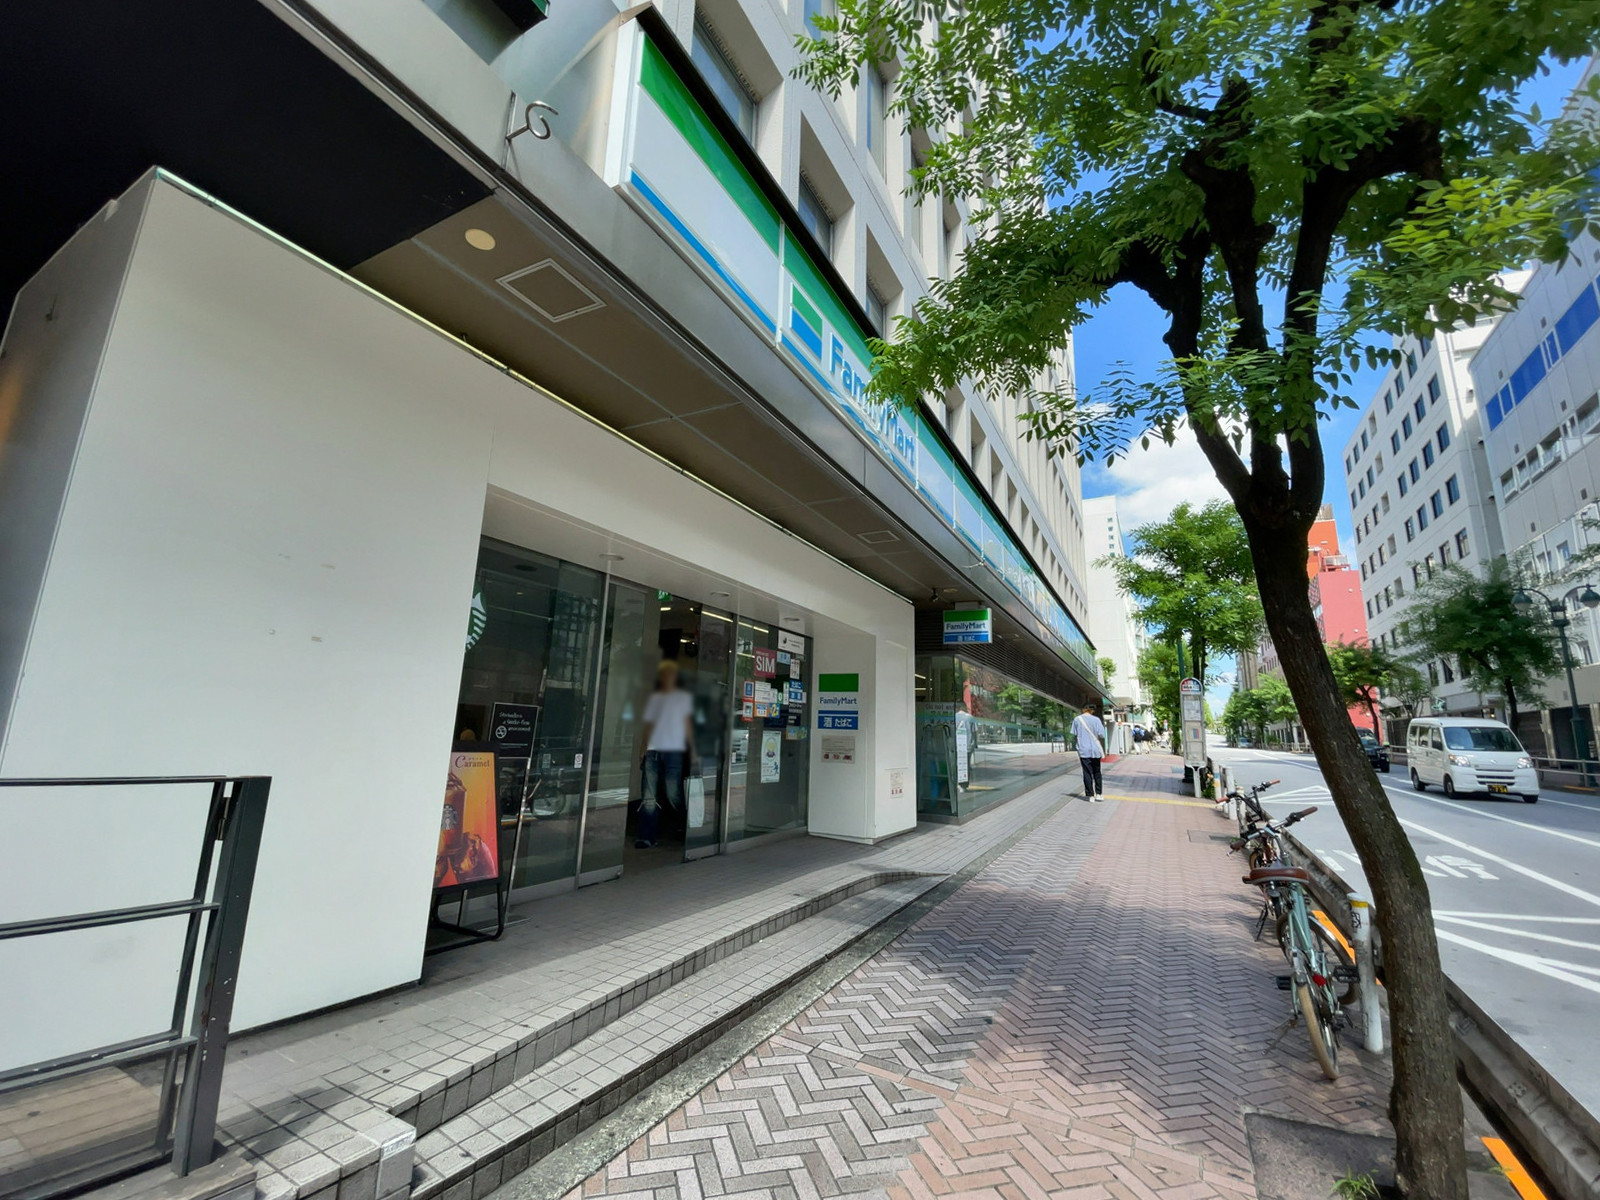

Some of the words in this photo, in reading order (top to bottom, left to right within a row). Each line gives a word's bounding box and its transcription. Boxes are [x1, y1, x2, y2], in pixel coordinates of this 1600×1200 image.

[946, 622, 986, 631] FamilyMart
[756, 656, 775, 673] SIM
[819, 697, 857, 706] FamilyMart
[823, 717, 832, 728] 酒
[834, 718, 853, 728] たばこ
[455, 755, 490, 769] Caramel
